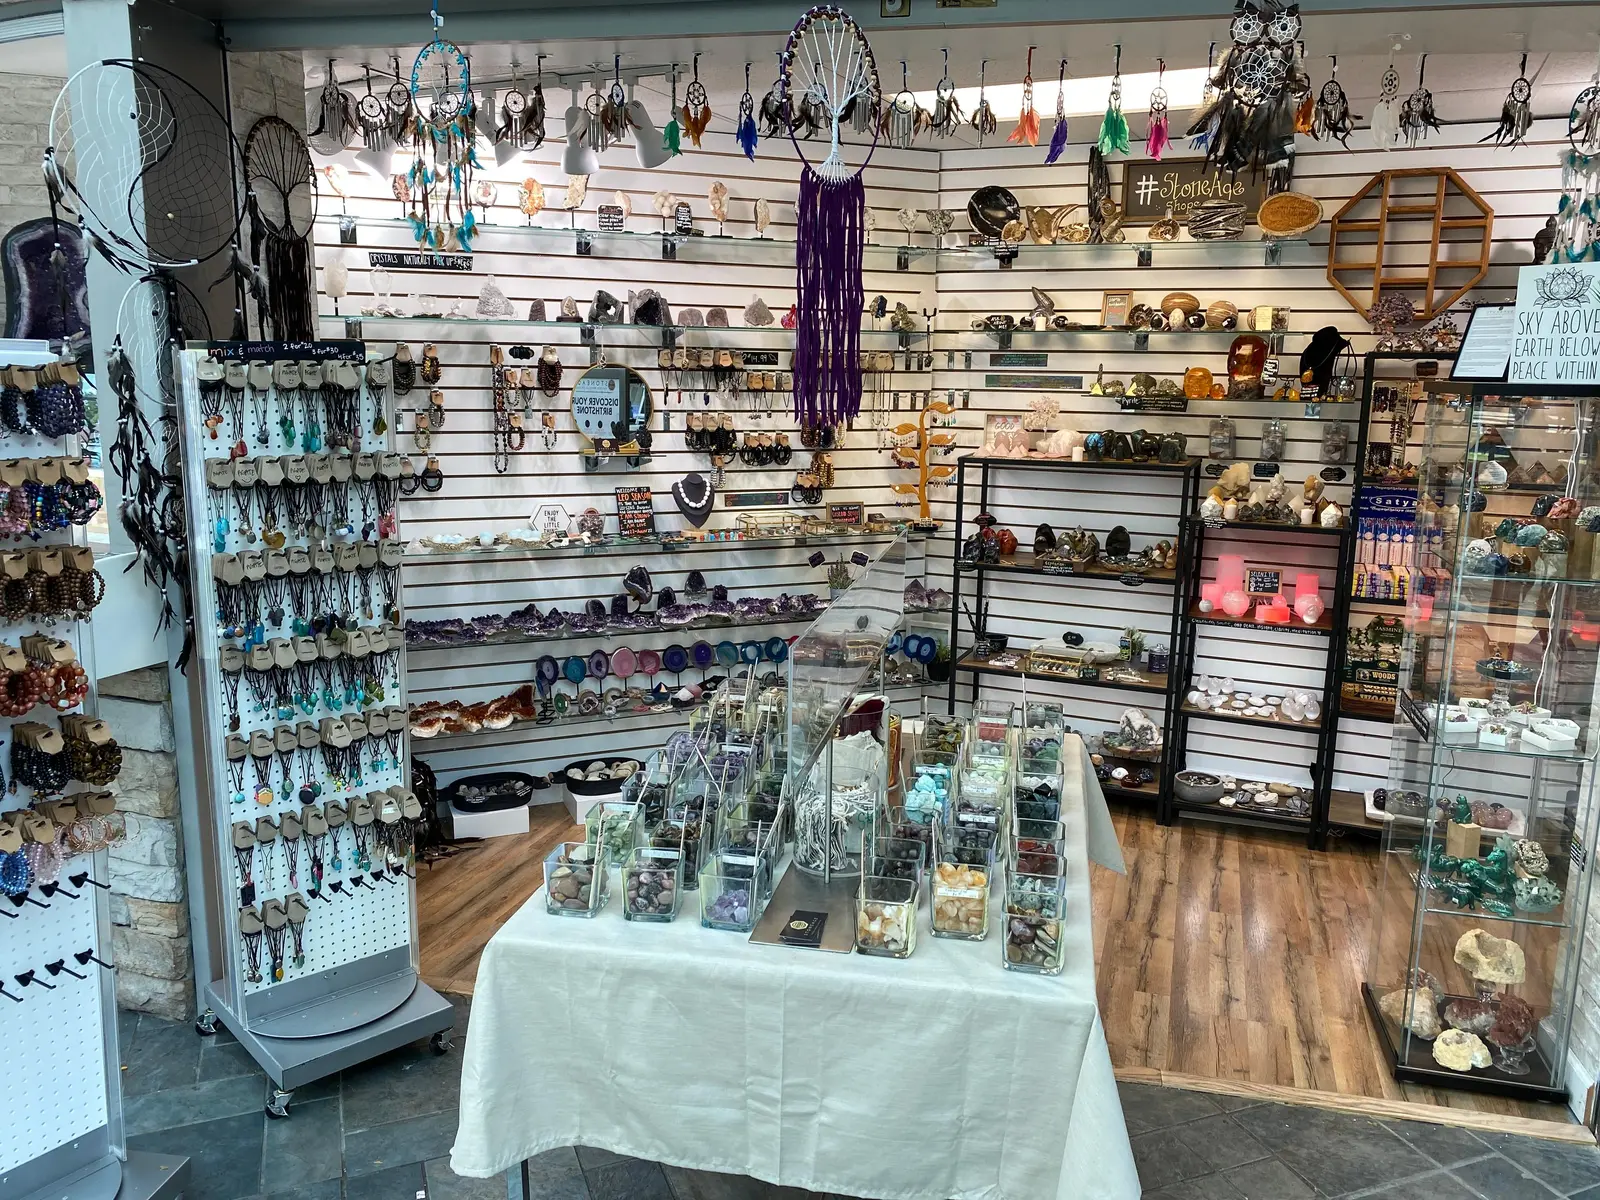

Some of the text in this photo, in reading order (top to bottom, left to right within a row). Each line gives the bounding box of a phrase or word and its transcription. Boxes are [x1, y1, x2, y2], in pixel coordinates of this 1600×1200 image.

[369, 253, 399, 264] CRYSTALS
[1517, 309, 1600, 336] SKY ABOVE
[209, 346, 235, 357] mix
[247, 344, 275, 354] match
[1514, 336, 1600, 358] EARTH BELOW
[1512, 361, 1598, 380] PEACE WITHIN
[995, 422, 1015, 430] GOOD
[618, 491, 652, 502] LEO SEASON
[1375, 497, 1417, 507] Satya
[1375, 625, 1403, 634] JASMINE
[1371, 671, 1397, 680] WOODS
[1363, 684, 1398, 692] WOOD
